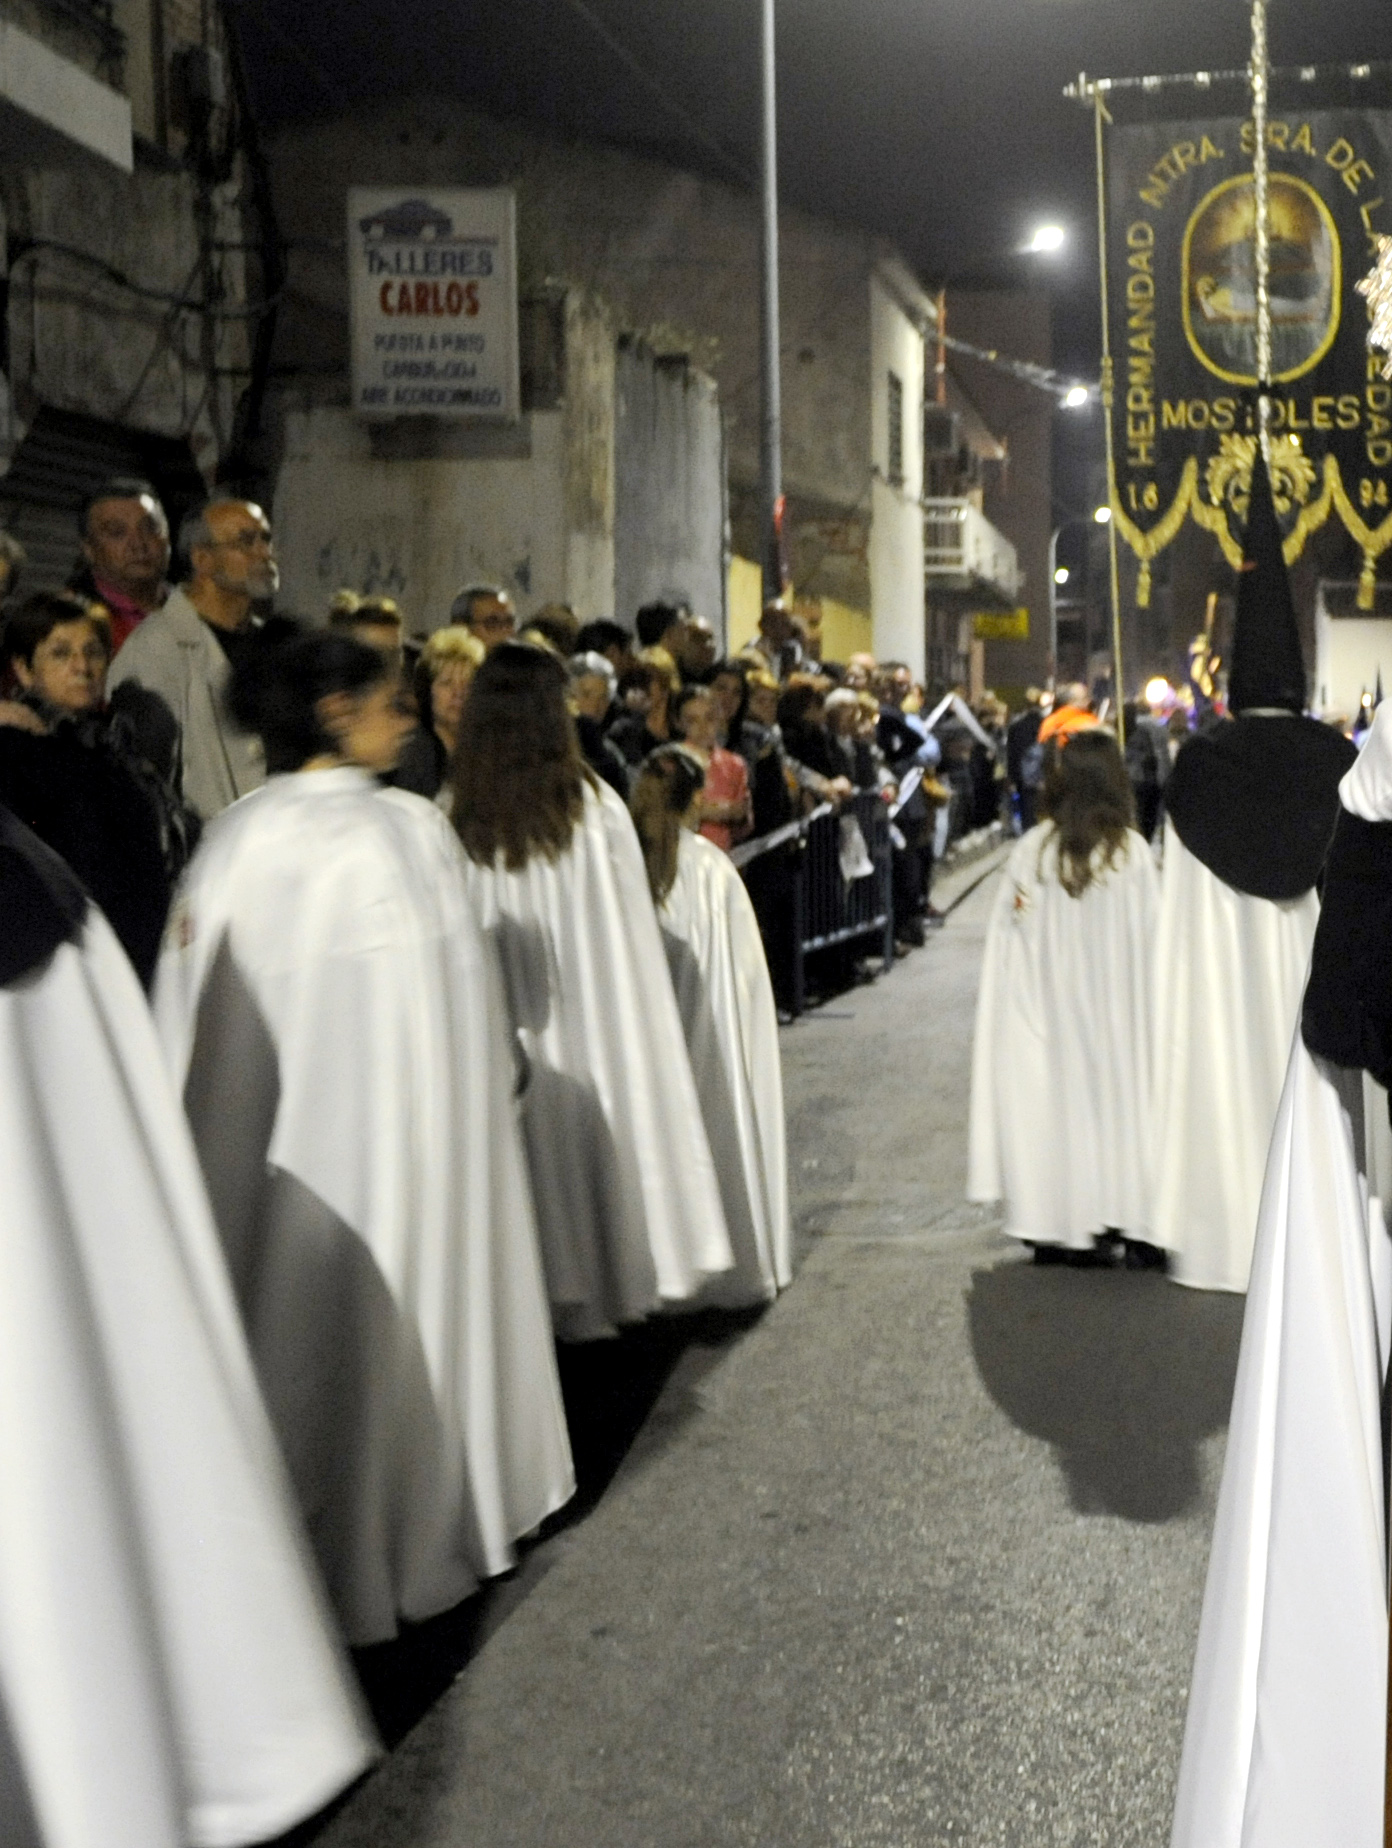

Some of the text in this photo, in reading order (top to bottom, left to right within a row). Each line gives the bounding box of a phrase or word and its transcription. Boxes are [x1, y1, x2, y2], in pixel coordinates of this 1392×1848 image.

[1139, 135, 1225, 209] NTRA.
[1325, 137, 1375, 196] DE
[365, 249, 493, 276] TALLERES
[379, 280, 480, 317] CARLOS
[1126, 220, 1155, 467] HERMANDAD
